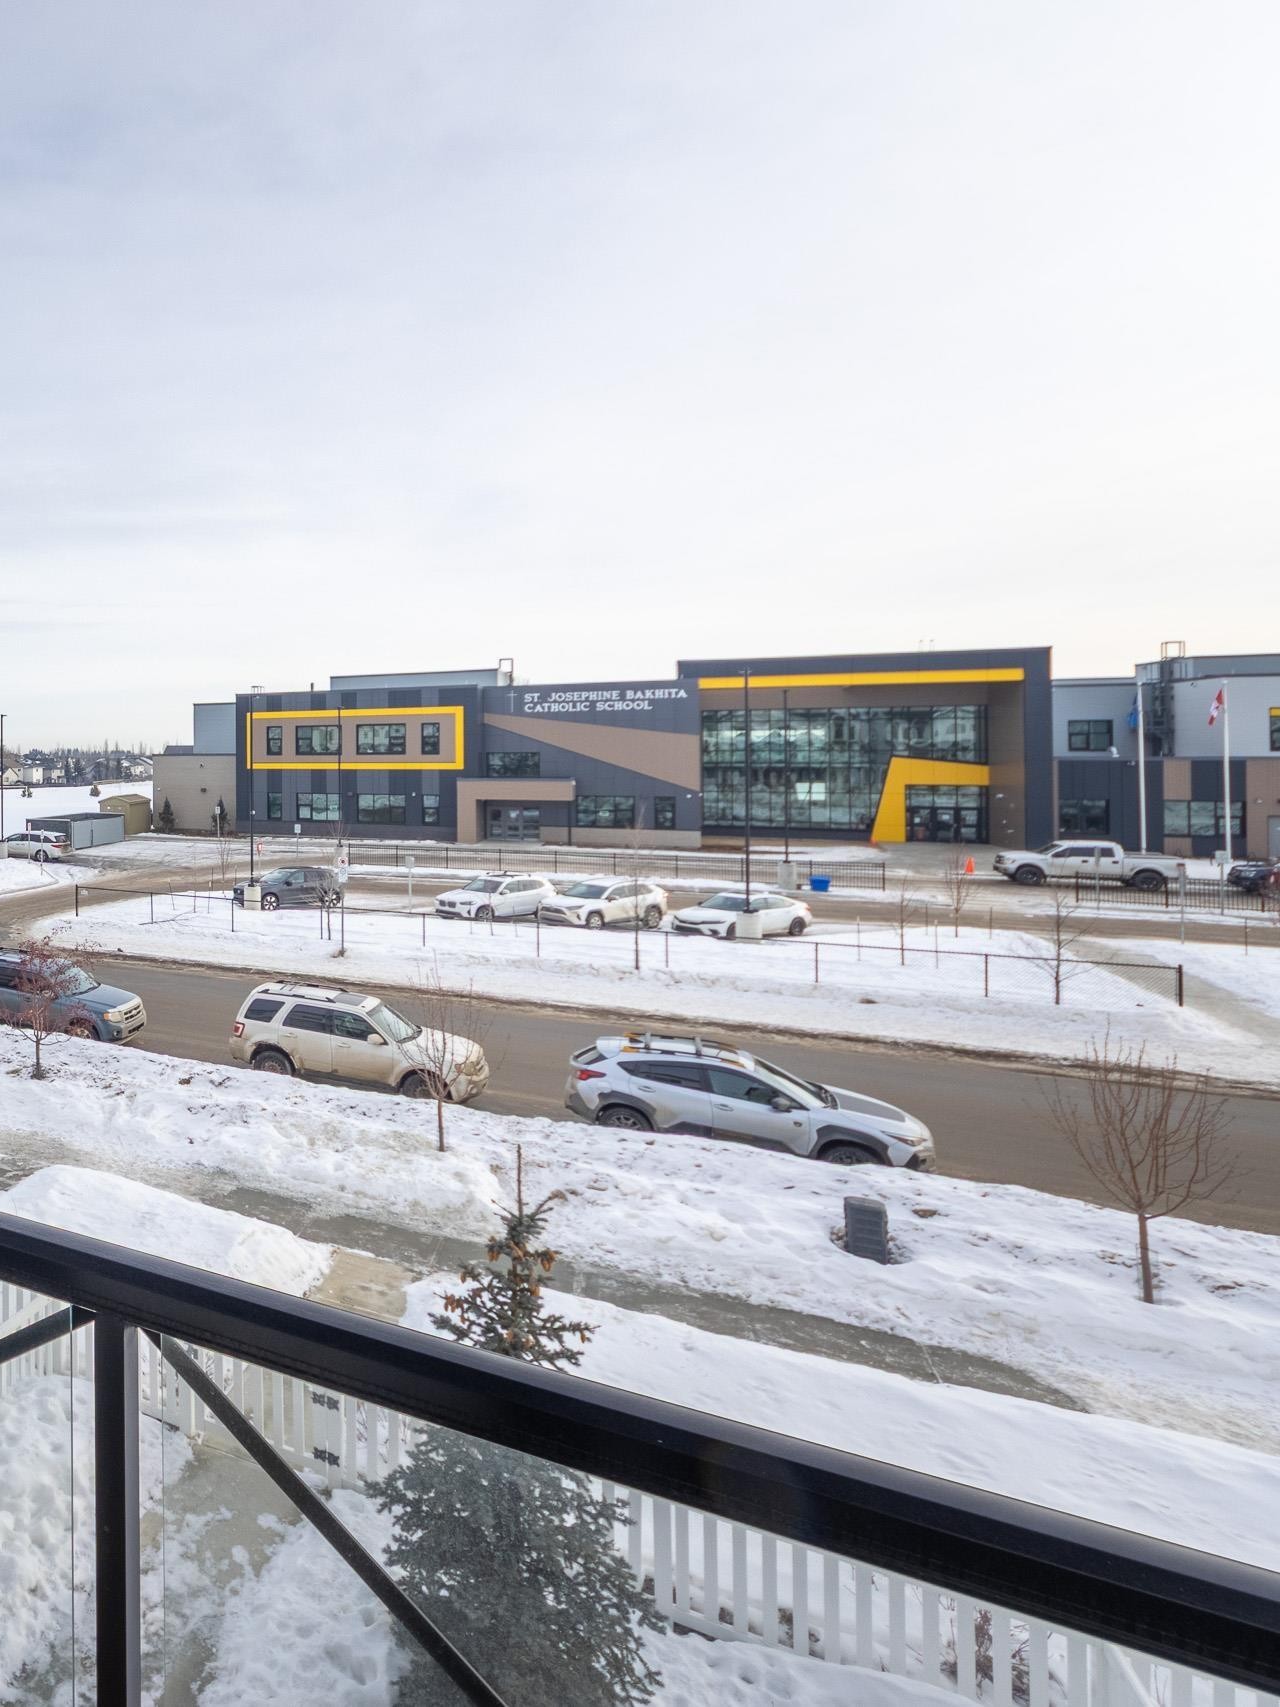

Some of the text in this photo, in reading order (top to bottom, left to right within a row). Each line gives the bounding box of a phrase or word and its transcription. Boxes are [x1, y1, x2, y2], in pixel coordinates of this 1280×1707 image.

[524, 688, 688, 703] ST. JOSEPHINE BAKHITA
[524, 701, 653, 713] CATHOLIC SCHOOL
